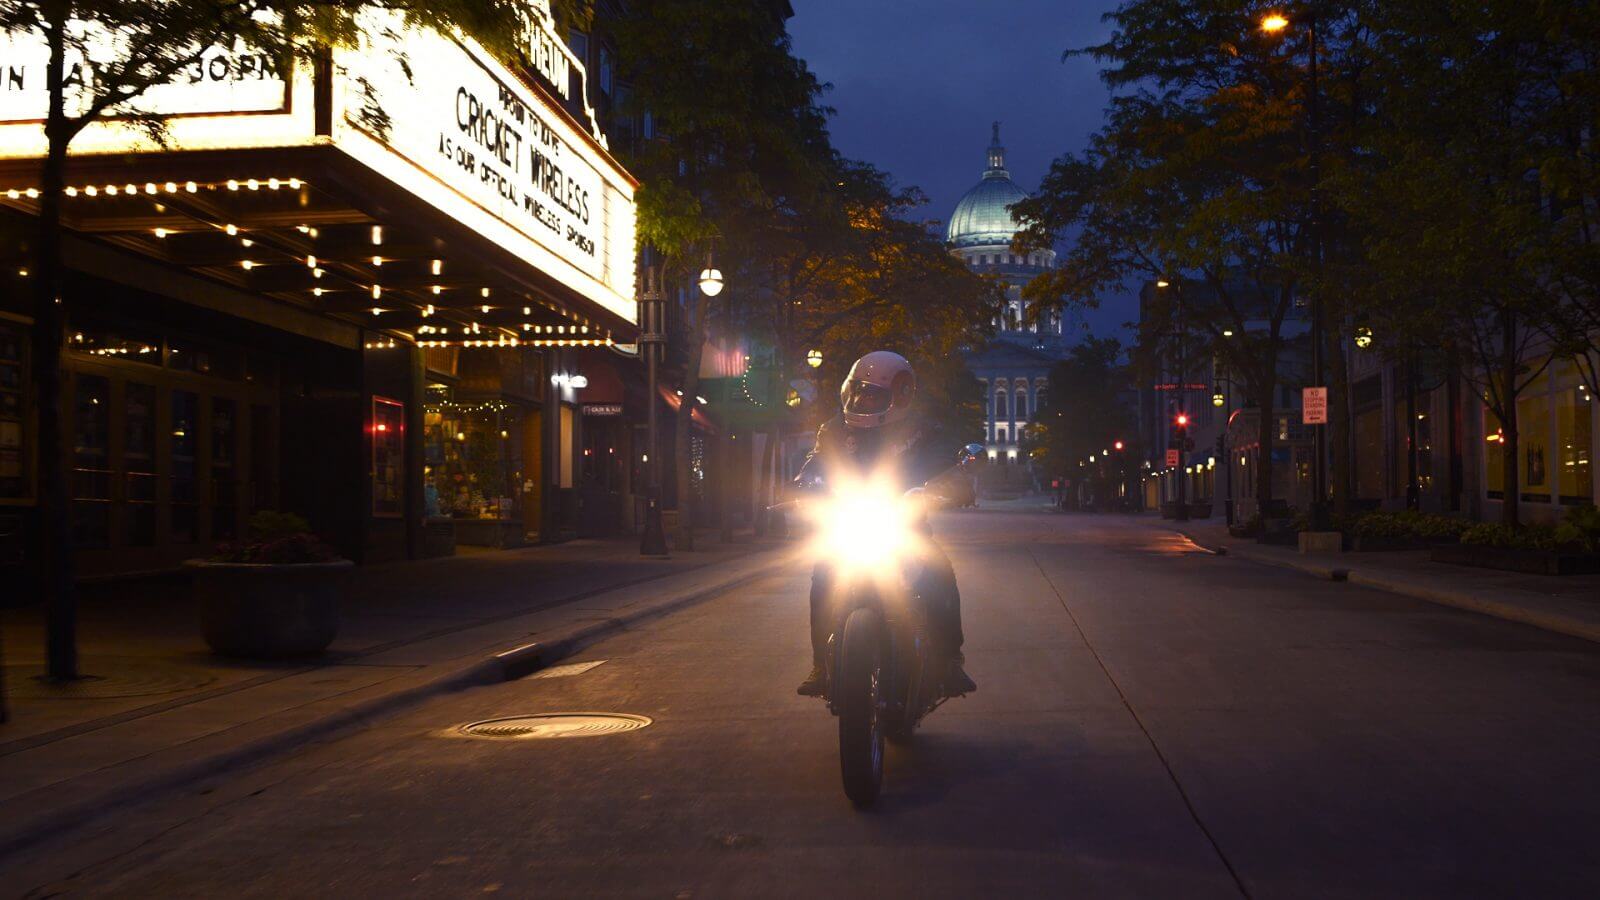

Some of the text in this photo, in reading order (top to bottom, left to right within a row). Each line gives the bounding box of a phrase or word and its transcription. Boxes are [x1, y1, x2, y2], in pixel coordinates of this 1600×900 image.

[439, 132, 453, 160] AS
[457, 145, 475, 174] OUR
[480, 161, 518, 206] OFFICIAL
[524, 193, 560, 235] WIRELESS
[456, 86, 589, 225] CRICKET WIRELESS
